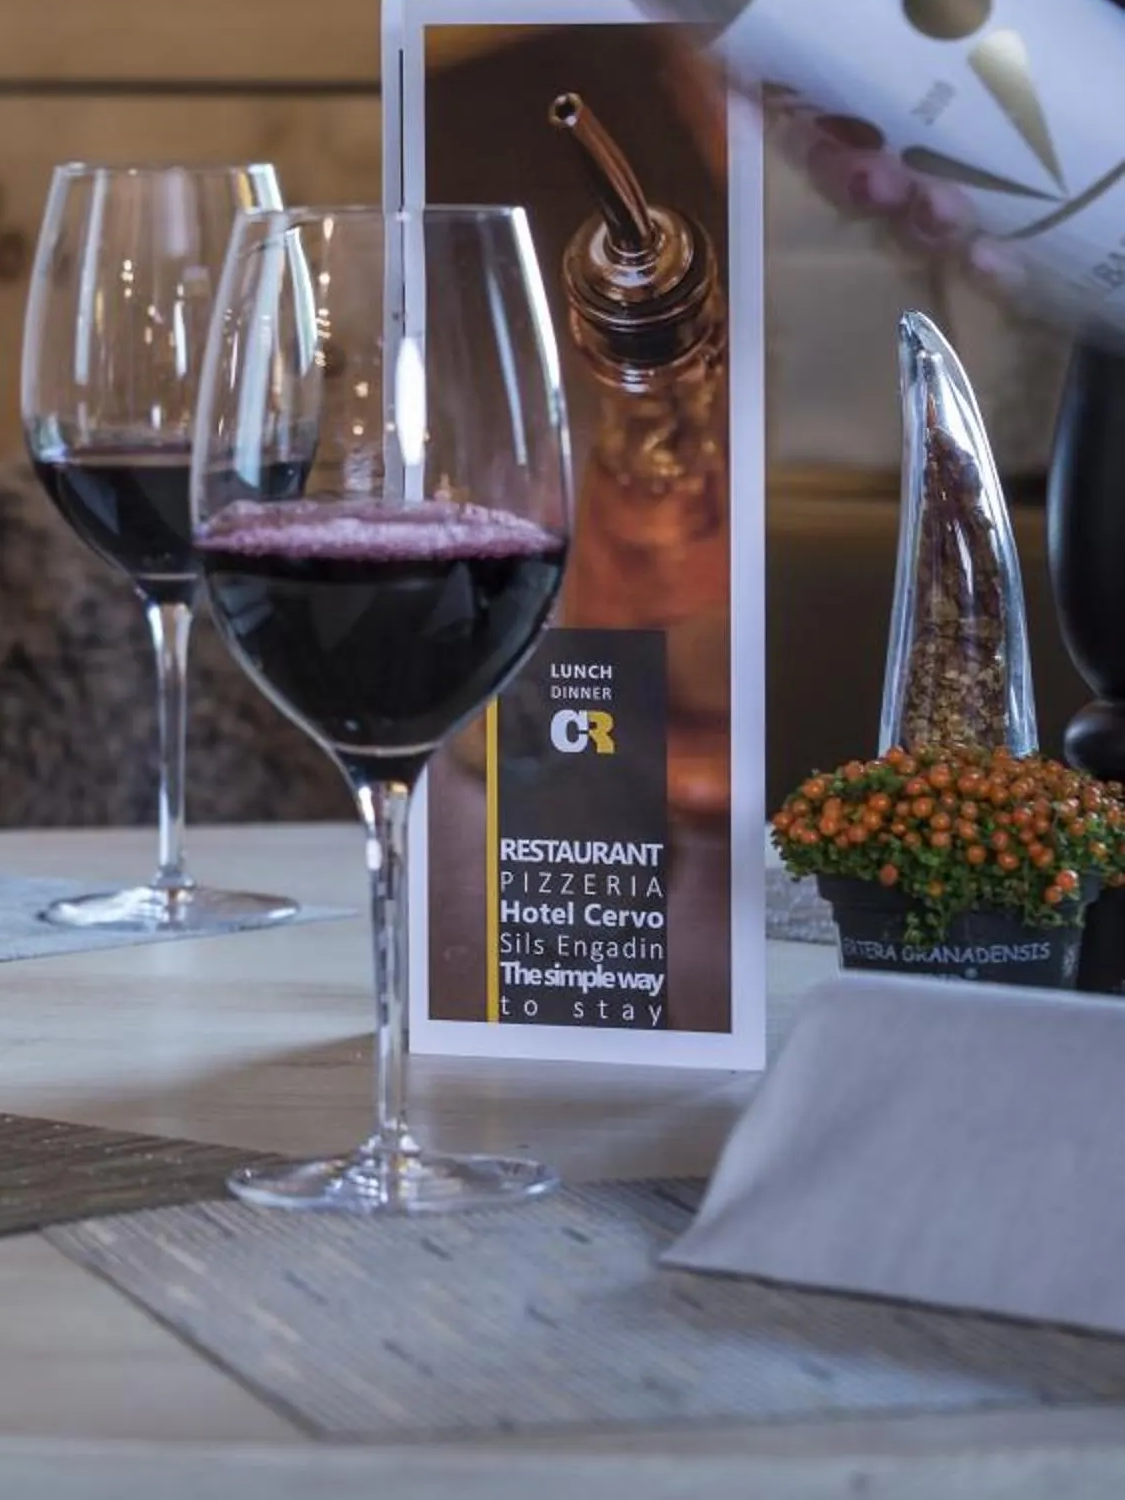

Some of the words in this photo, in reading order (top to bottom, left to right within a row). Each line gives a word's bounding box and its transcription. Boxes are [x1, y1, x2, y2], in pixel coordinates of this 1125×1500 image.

[550, 663, 612, 679] LUNCH
[550, 685, 612, 700] DINNER
[550, 709, 615, 753] CR
[500, 838, 663, 867] RESTAURANT
[500, 871, 663, 898] PIZZERIA
[500, 900, 574, 924] Hotel
[584, 903, 664, 929] Cervo
[500, 932, 545, 955] Sils
[558, 934, 663, 963] Engadin
[500, 995, 538, 1017] to
[573, 1000, 662, 1026] stay
